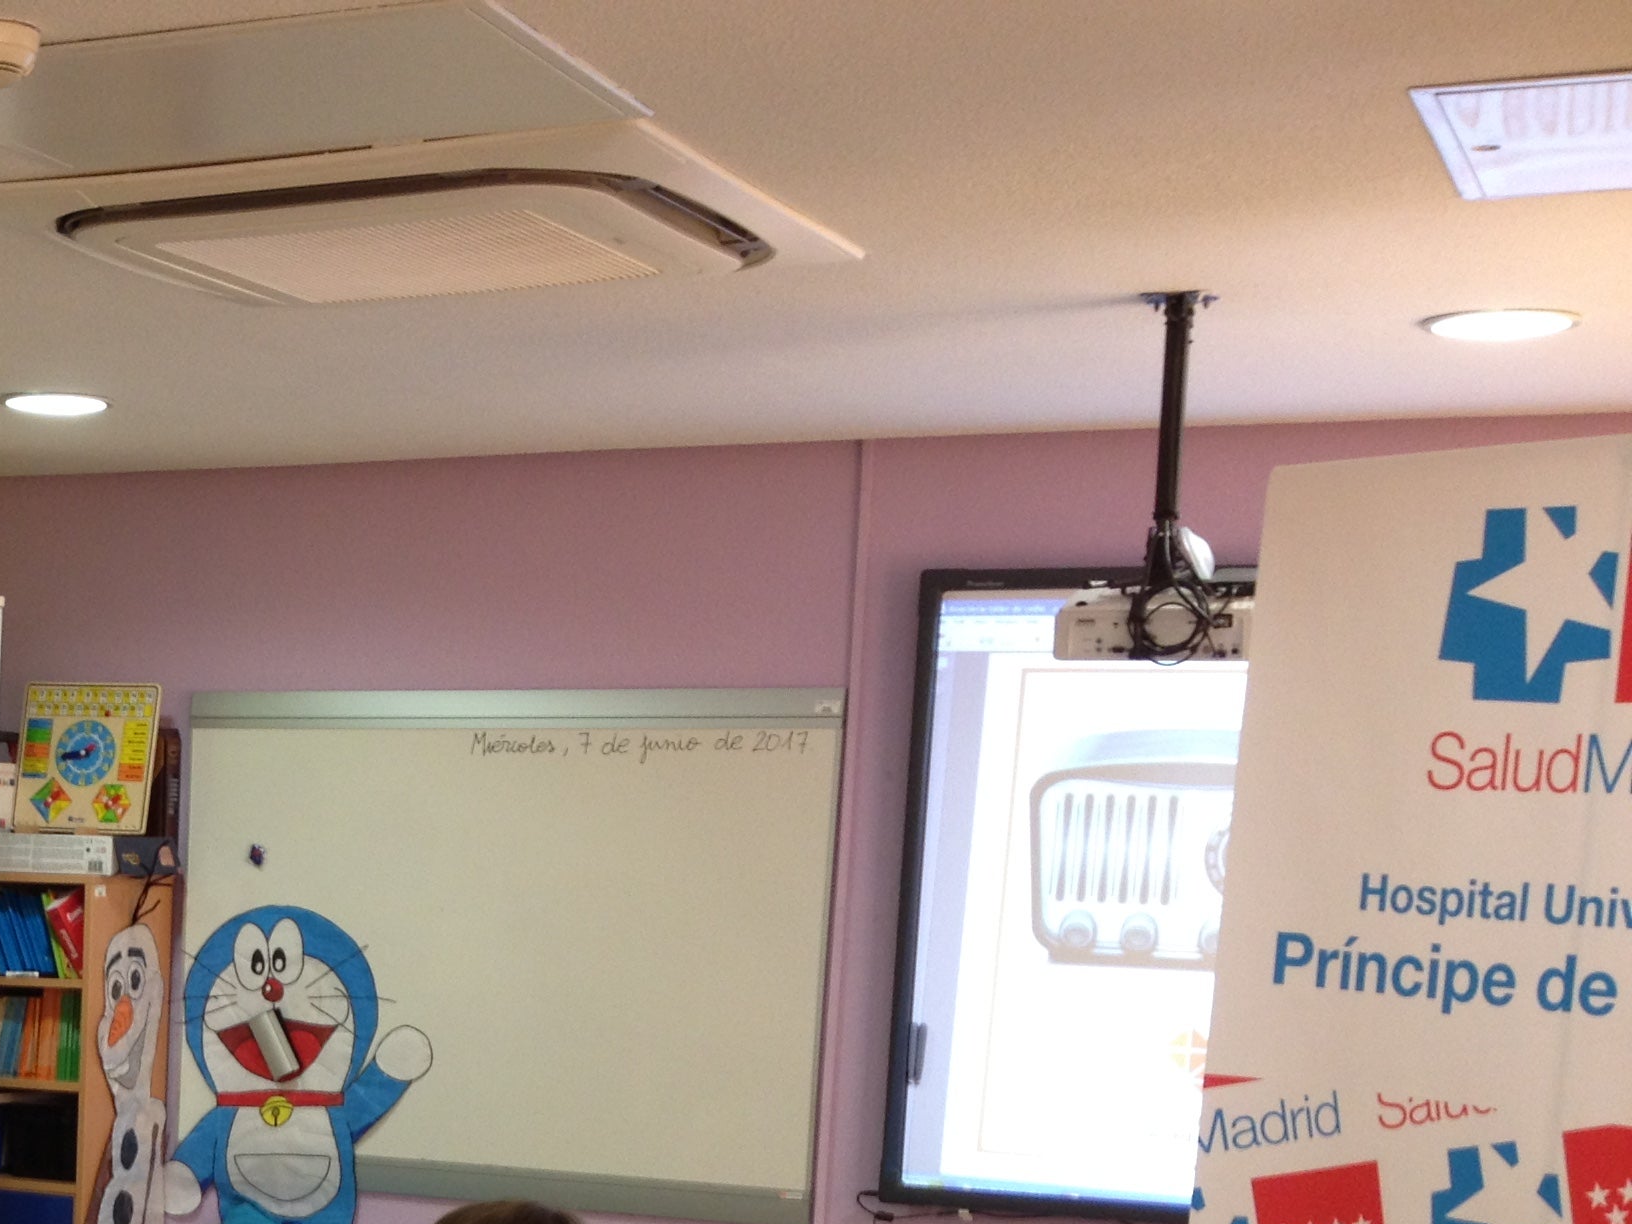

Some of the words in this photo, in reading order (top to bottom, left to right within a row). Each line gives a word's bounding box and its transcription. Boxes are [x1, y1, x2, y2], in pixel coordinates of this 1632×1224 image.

[470, 730, 568, 757] Miércoles,
[577, 731, 592, 755] 7
[601, 731, 629, 756] de
[639, 731, 702, 765] junio
[714, 729, 744, 752] de
[752, 730, 809, 754] 2017
[1427, 731, 1632, 793] SaludM
[1359, 872, 1531, 926] Hospital
[1272, 930, 1516, 1015] Príncipe
[1536, 953, 1618, 1018] de
